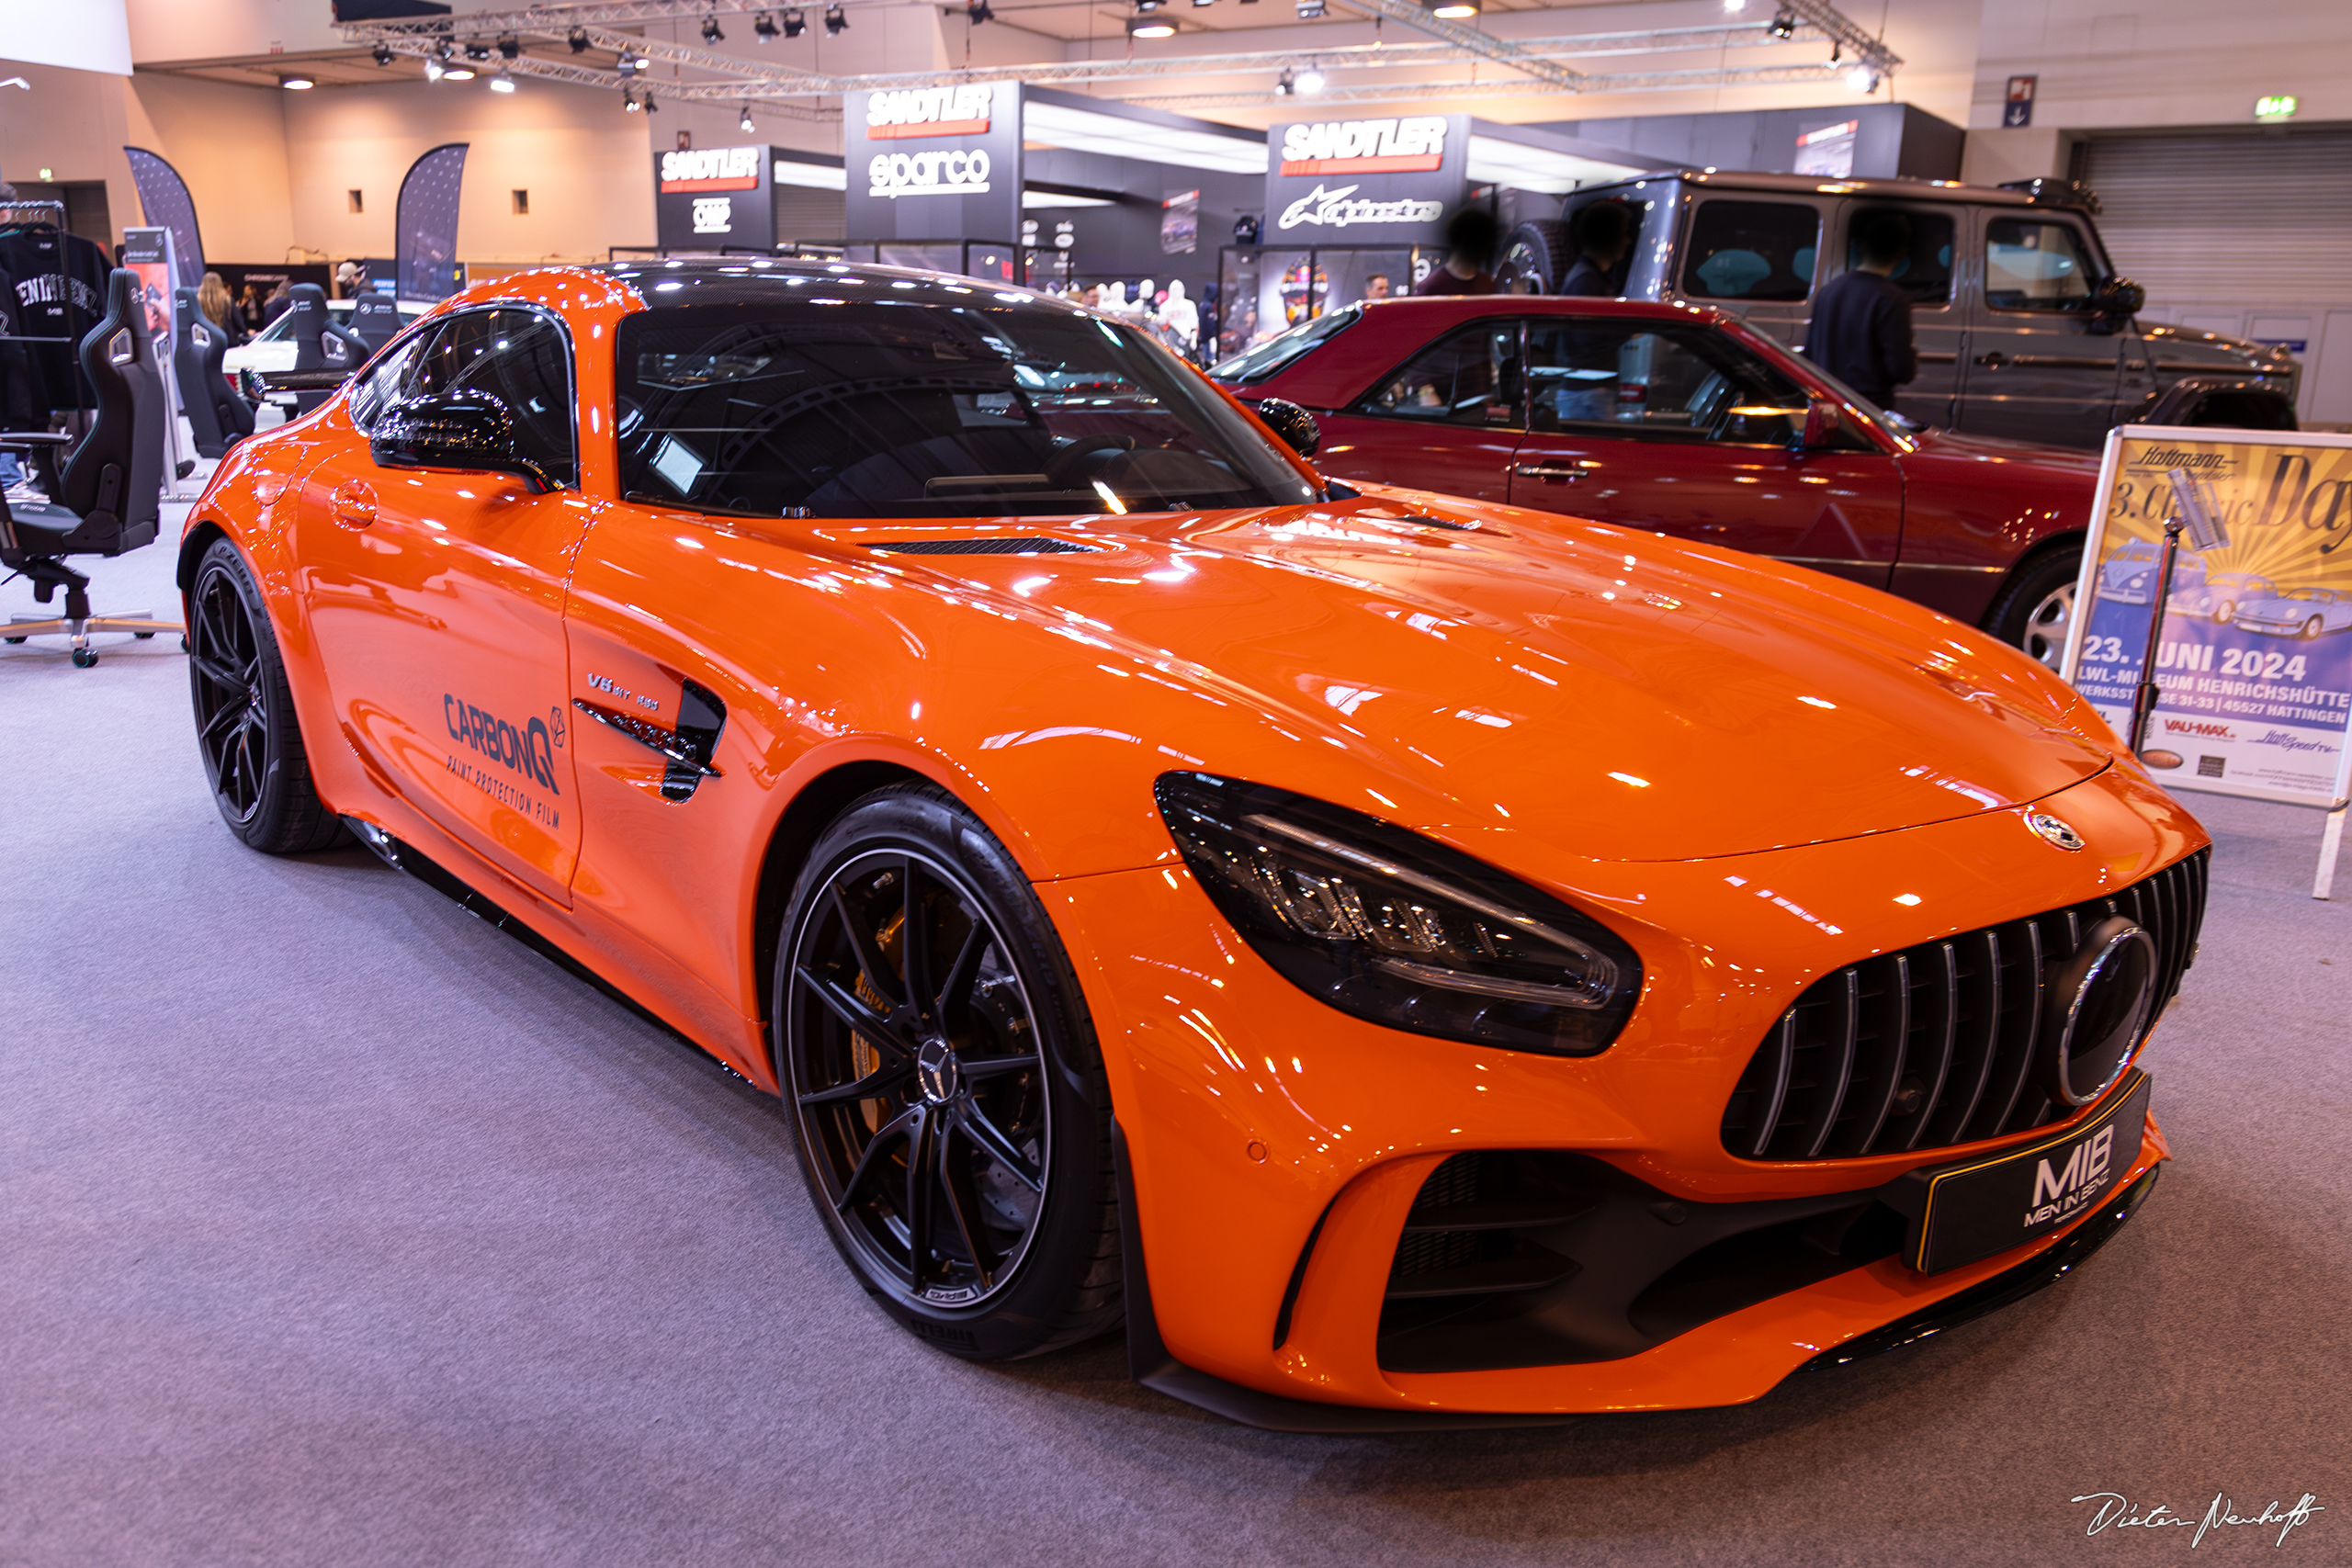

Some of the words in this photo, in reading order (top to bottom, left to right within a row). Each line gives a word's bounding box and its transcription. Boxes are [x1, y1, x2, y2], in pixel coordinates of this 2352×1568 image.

[866, 85, 993, 126] SANDTLER
[1282, 117, 1448, 161] SANDTLER
[661, 147, 760, 181] SANDTLER
[869, 149, 990, 198] sparco
[693, 204, 731, 227] OMP
[2081, 635, 2130, 664] 23.
[2135, 640, 2215, 671] UNI
[2220, 648, 2307, 682] 2024
[2077, 666, 2195, 691] LWL-MEUM
[2197, 677, 2351, 708] HENRICHSHÜTTE
[2222, 699, 2266, 715] 45527
[2266, 704, 2346, 724] HATTINGEN
[447, 755, 471, 782] PAINT
[476, 770, 531, 816] PROTECTION
[537, 802, 560, 830] FILM
[2031, 1123, 2114, 1208] MIB
[2023, 1200, 2062, 1227] MEN
[2064, 1191, 2079, 1211] IN
[2080, 1168, 2109, 1201] BENZ
